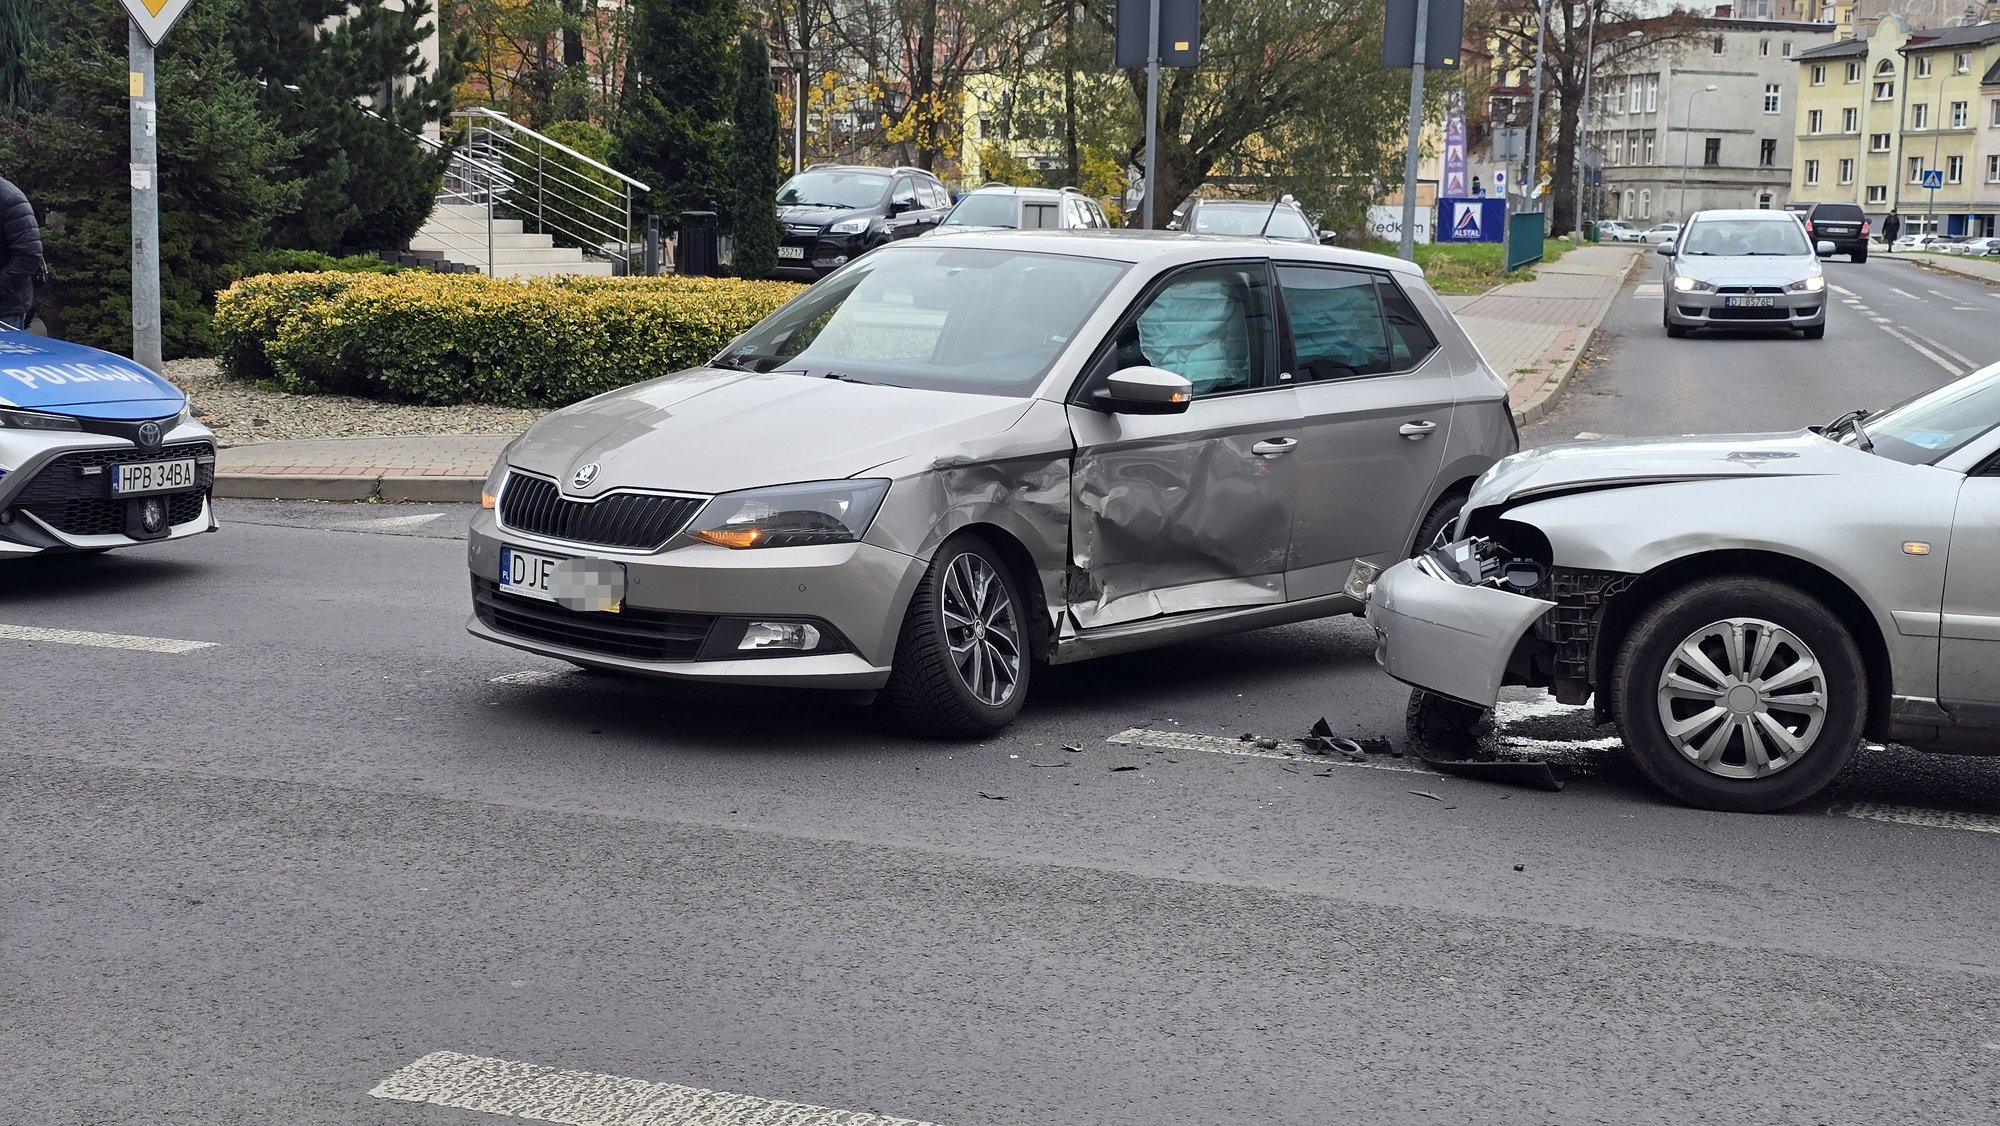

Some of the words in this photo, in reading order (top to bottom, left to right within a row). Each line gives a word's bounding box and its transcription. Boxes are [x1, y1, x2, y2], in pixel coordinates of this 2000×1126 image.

[1371, 222, 1423, 233] redkm
[1454, 229, 1480, 237] ALSTAL
[781, 247, 803, 256] 55717
[1, 363, 154, 389] POLICJA
[122, 466, 152, 491] HPB
[156, 463, 191, 487] 34BA
[513, 554, 555, 590] DJE
